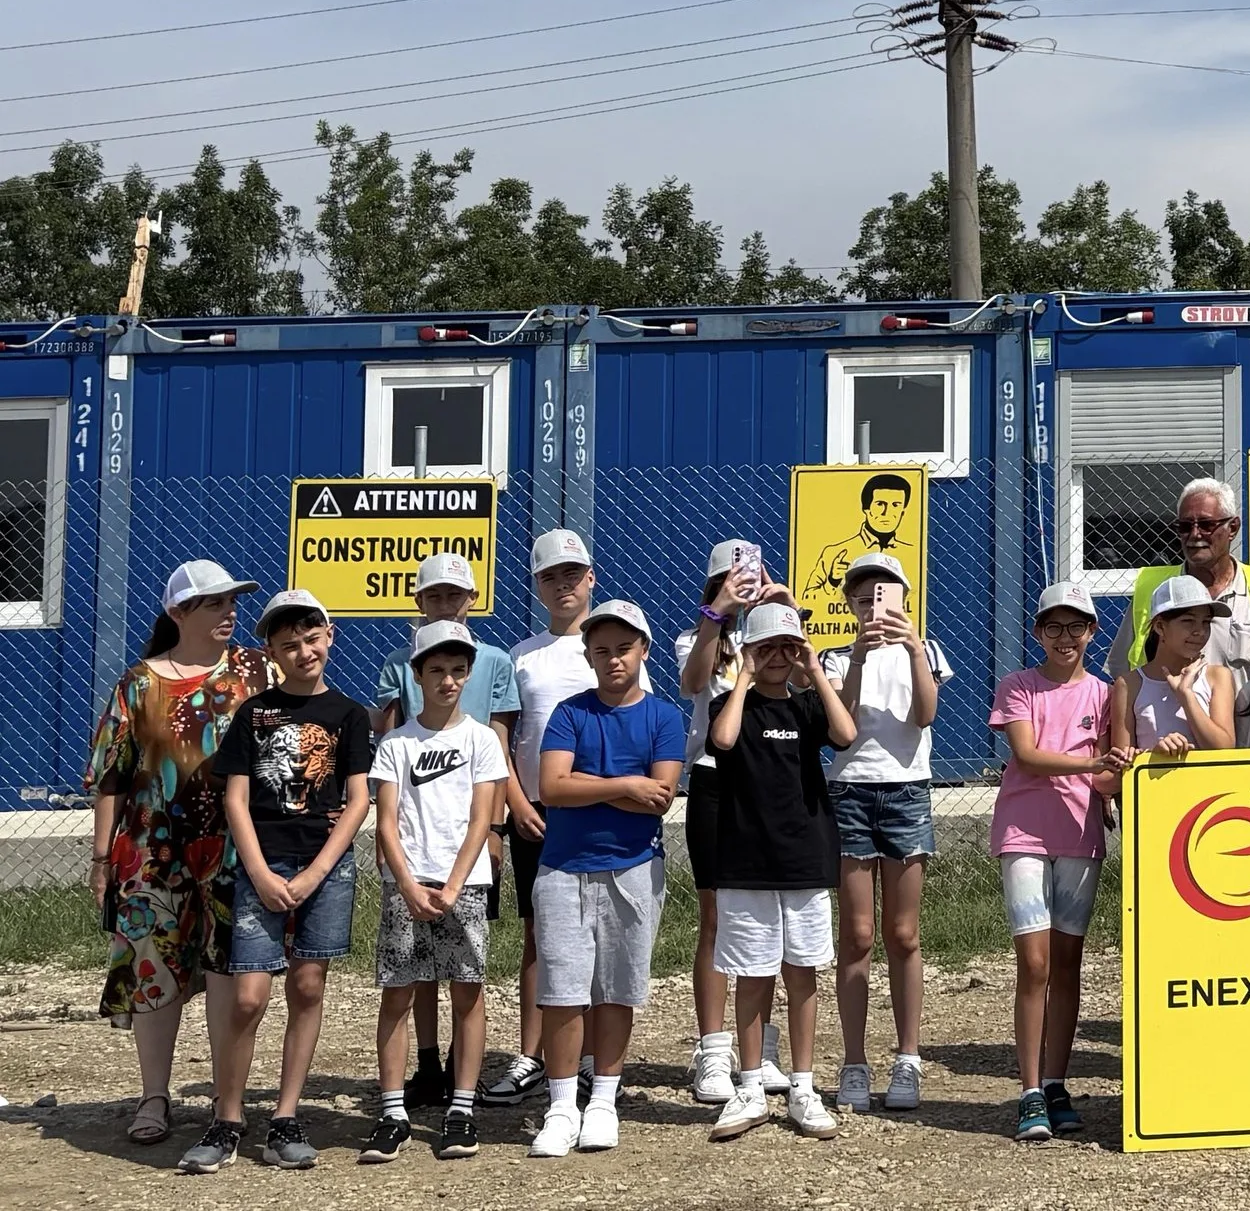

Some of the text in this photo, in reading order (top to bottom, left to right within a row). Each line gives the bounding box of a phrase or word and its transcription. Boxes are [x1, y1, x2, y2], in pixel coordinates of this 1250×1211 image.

[75, 376, 92, 472] 1241
[542, 379, 554, 463] 1029
[1003, 381, 1015, 444] 999
[110, 392, 124, 474] 1029
[354, 490, 477, 511] ATTENTION
[302, 536, 483, 562] CONSTRUCTION
[366, 572, 417, 597] SITE
[807, 622, 840, 635] EALTH
[843, 621, 859, 635] AN
[763, 729, 798, 739] adidas
[415, 749, 460, 771] NIKE
